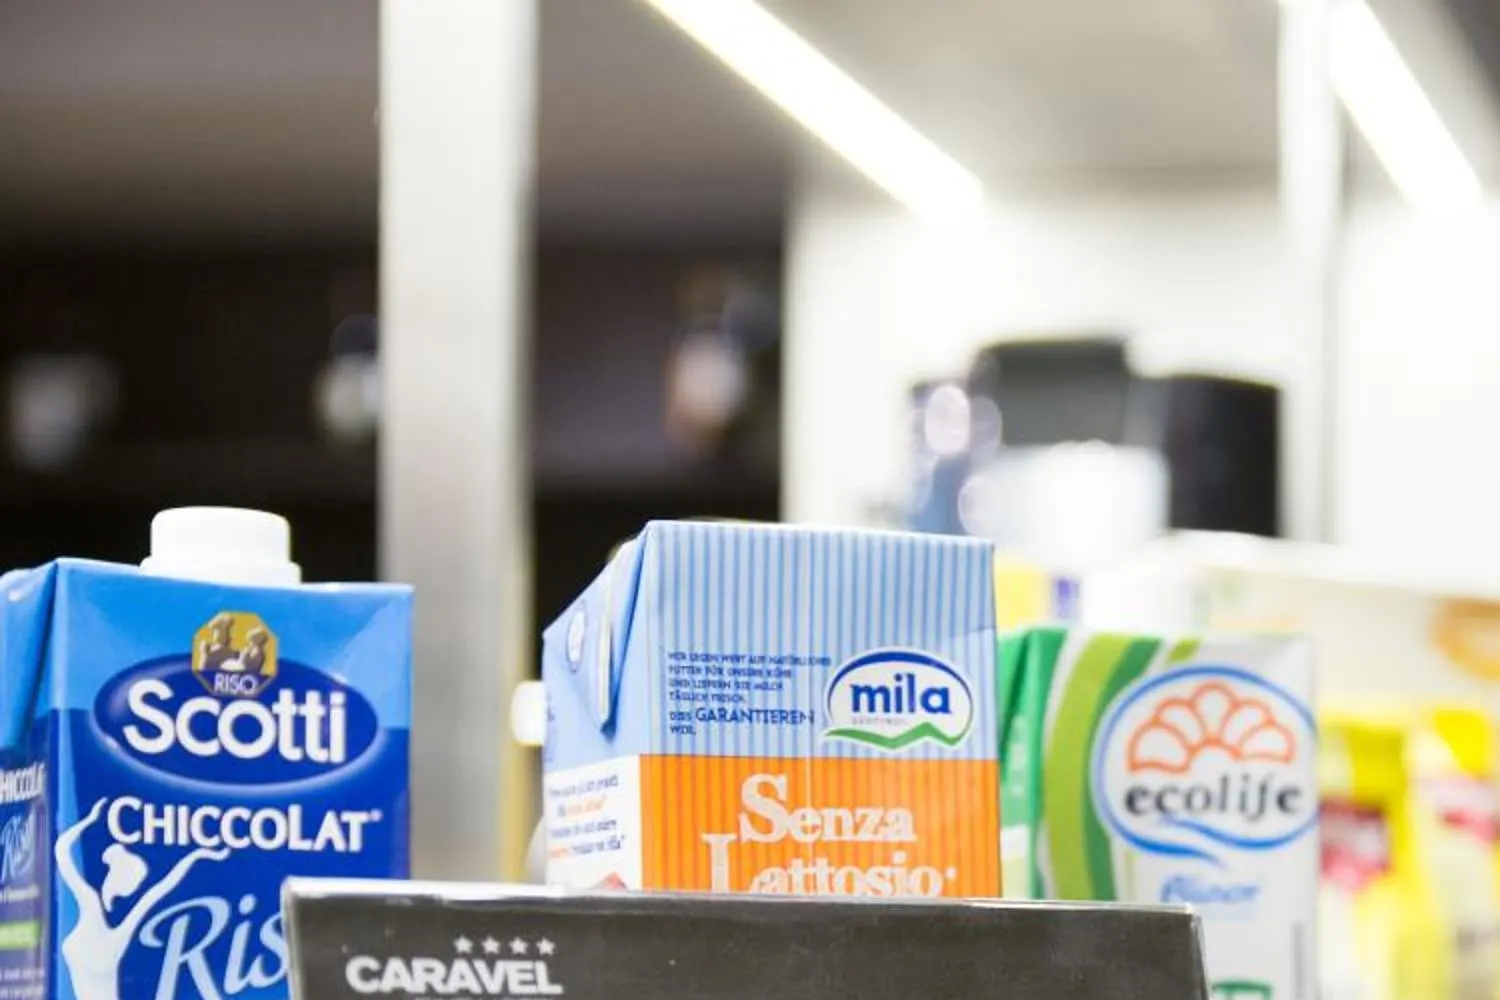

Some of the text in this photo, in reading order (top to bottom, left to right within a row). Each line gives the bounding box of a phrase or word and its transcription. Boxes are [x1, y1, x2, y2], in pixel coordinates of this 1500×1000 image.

[213, 672, 257, 694] RISO
[850, 673, 951, 714] mila
[122, 679, 346, 764] Scotti
[695, 707, 815, 725] GARANTIEREN
[738, 774, 917, 843] Senza
[1124, 773, 1303, 823] ecolife
[345, 955, 564, 995] CARAVEL
